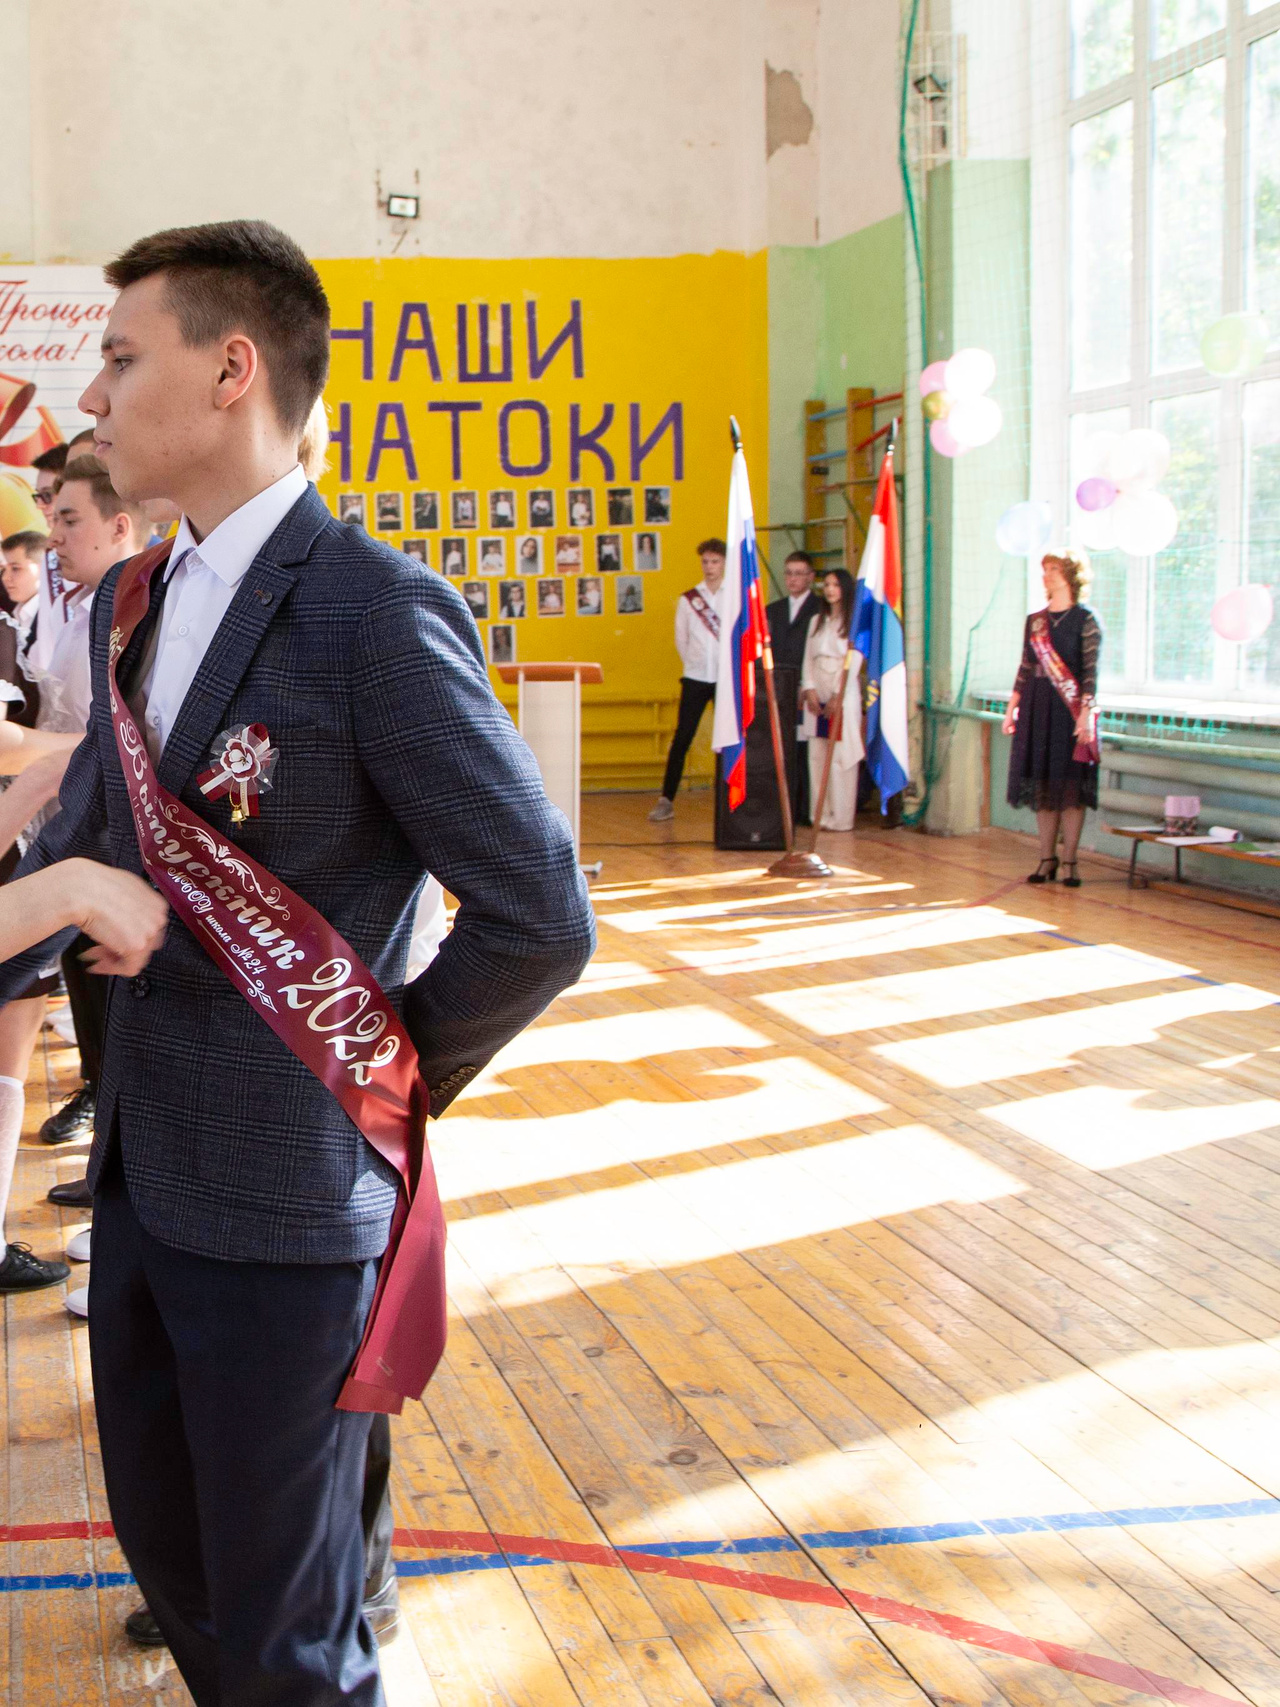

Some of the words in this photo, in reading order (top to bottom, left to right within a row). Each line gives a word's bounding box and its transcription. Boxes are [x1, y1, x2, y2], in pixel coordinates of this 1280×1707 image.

[120, 717, 308, 970] Выпускник
[278, 957, 401, 1086] 2022
[205, 914, 233, 943] школа
